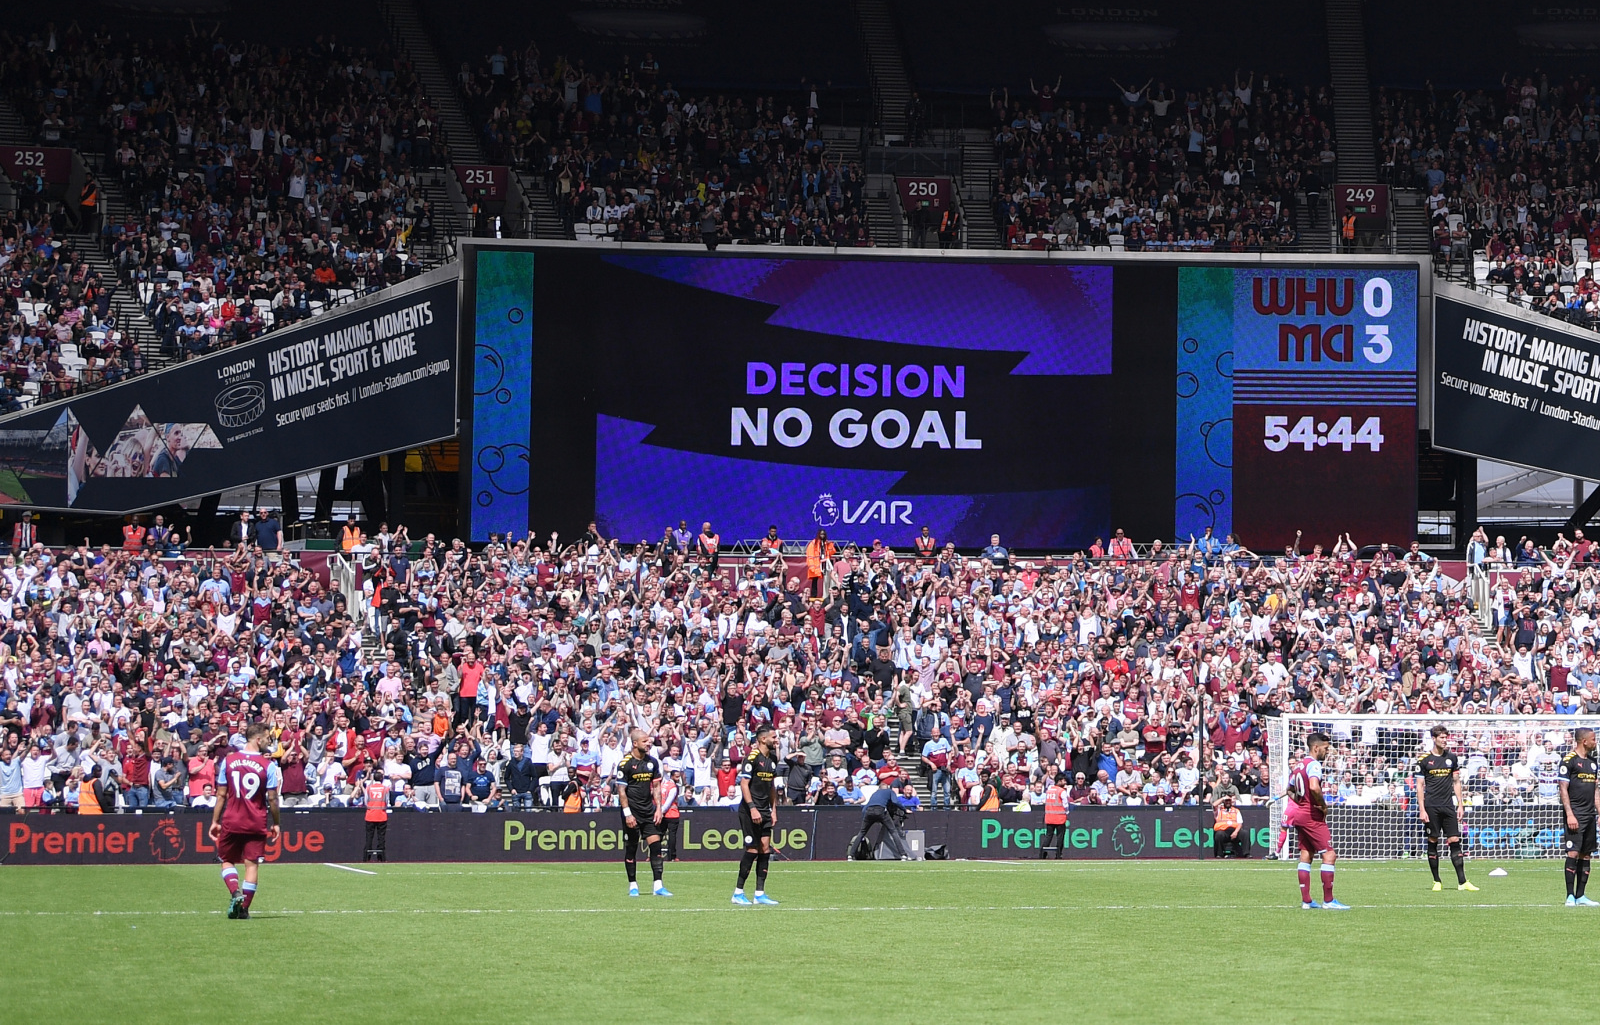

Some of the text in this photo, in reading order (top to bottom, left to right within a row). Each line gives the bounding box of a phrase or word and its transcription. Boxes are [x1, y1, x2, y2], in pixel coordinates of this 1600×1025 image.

[1056, 6, 1160, 17] LONDON
[14, 150, 45, 167] 252
[465, 169, 495, 185] 251
[908, 182, 938, 197] 250
[1346, 188, 1376, 203] 249
[1252, 276, 1393, 317] WHU 0
[268, 300, 434, 376] HISTORY-MAKING MOMENTS
[1278, 323, 1393, 364] MCI 3
[1462, 317, 1590, 374] HISTORY-MAKING
[217, 358, 256, 380] LONDON
[224, 371, 251, 386] STADIUM
[271, 332, 418, 402] IN MUSIC, SPORT & MORE
[746, 361, 965, 398] DECISION
[1481, 349, 1500, 374] IN
[1499, 355, 1550, 393] MUSIC,
[275, 408, 301, 428] Secure
[300, 403, 317, 421] your
[316, 397, 336, 415] seats
[335, 391, 351, 409] first
[358, 358, 451, 400] London-Stadium.com/signup
[1440, 371, 1469, 392] Secure
[1469, 381, 1488, 399] your
[1488, 386, 1511, 405] seats
[1510, 391, 1530, 410] first
[226, 434, 236, 444] THE
[730, 407, 982, 449] NO GOAL
[1263, 415, 1385, 452] 54:44
[842, 499, 914, 525] VAR
[229, 758, 264, 773] WILSHERE
[632, 772, 653, 780] ETIHAD
[231, 770, 261, 800] 19
[372, 791, 383, 799] 73
[9, 822, 140, 854] Premier
[683, 820, 808, 852] Leaue
